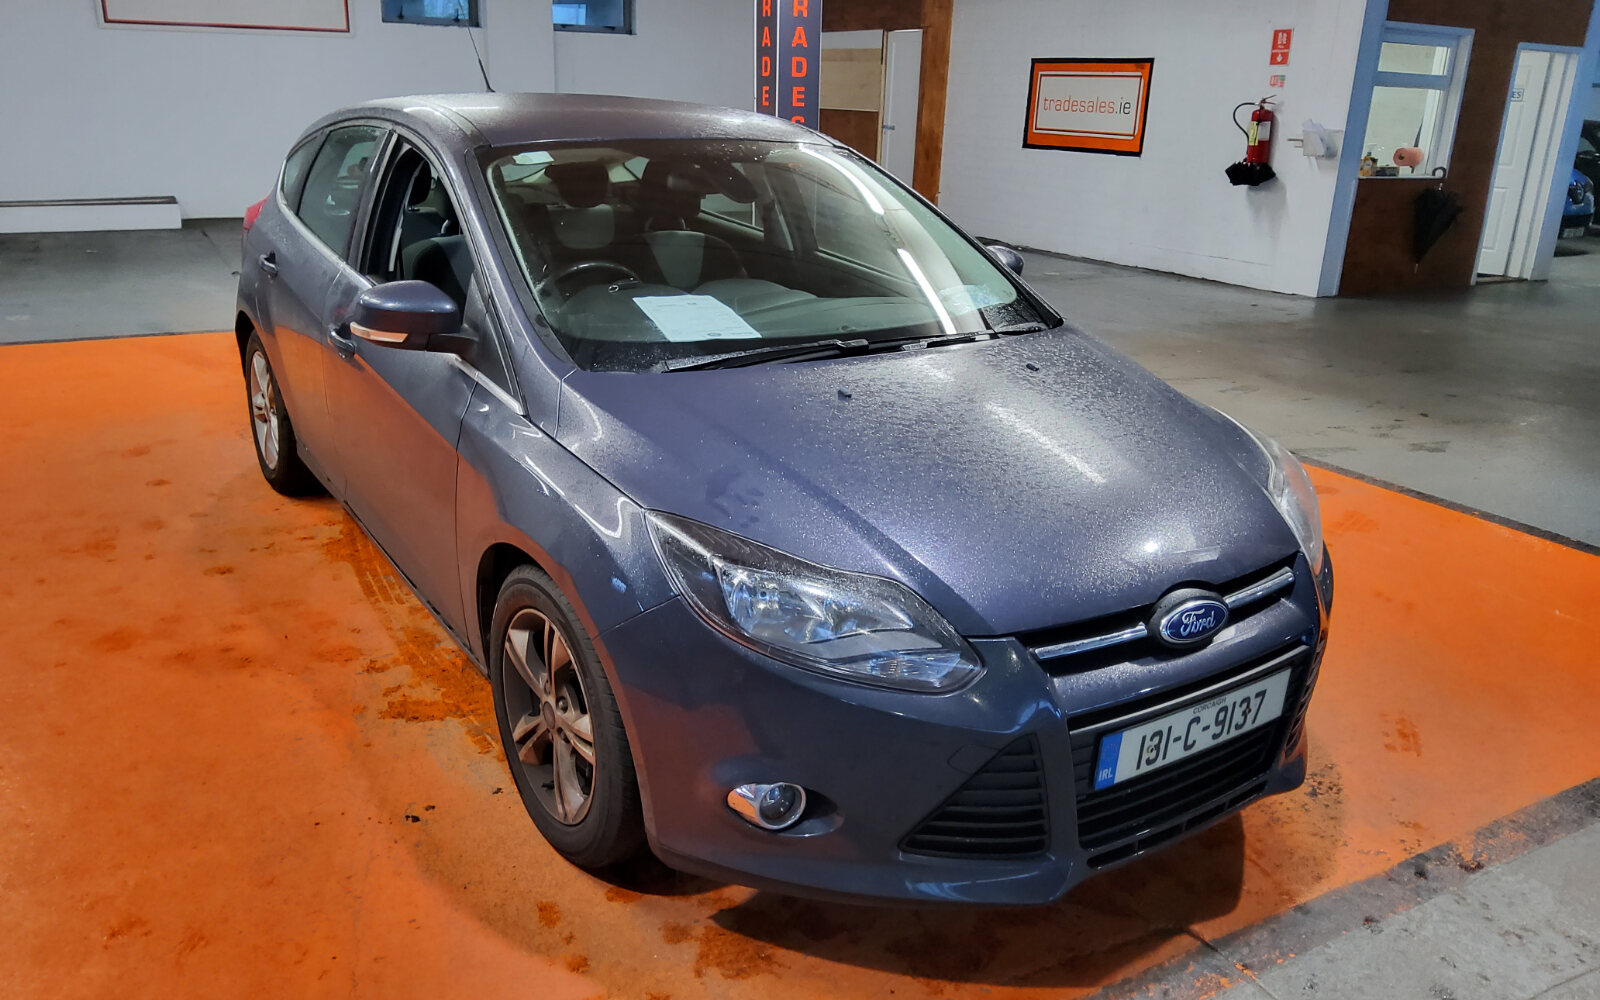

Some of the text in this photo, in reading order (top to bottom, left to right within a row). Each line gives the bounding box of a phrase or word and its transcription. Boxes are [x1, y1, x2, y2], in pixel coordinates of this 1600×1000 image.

[1043, 96, 1131, 115] tradesales.ie
[1180, 608, 1216, 637] Ford
[1193, 696, 1227, 715] CORCAIGH
[1135, 689, 1268, 770] 131-C-9137
[1098, 767, 1113, 782] IRL
